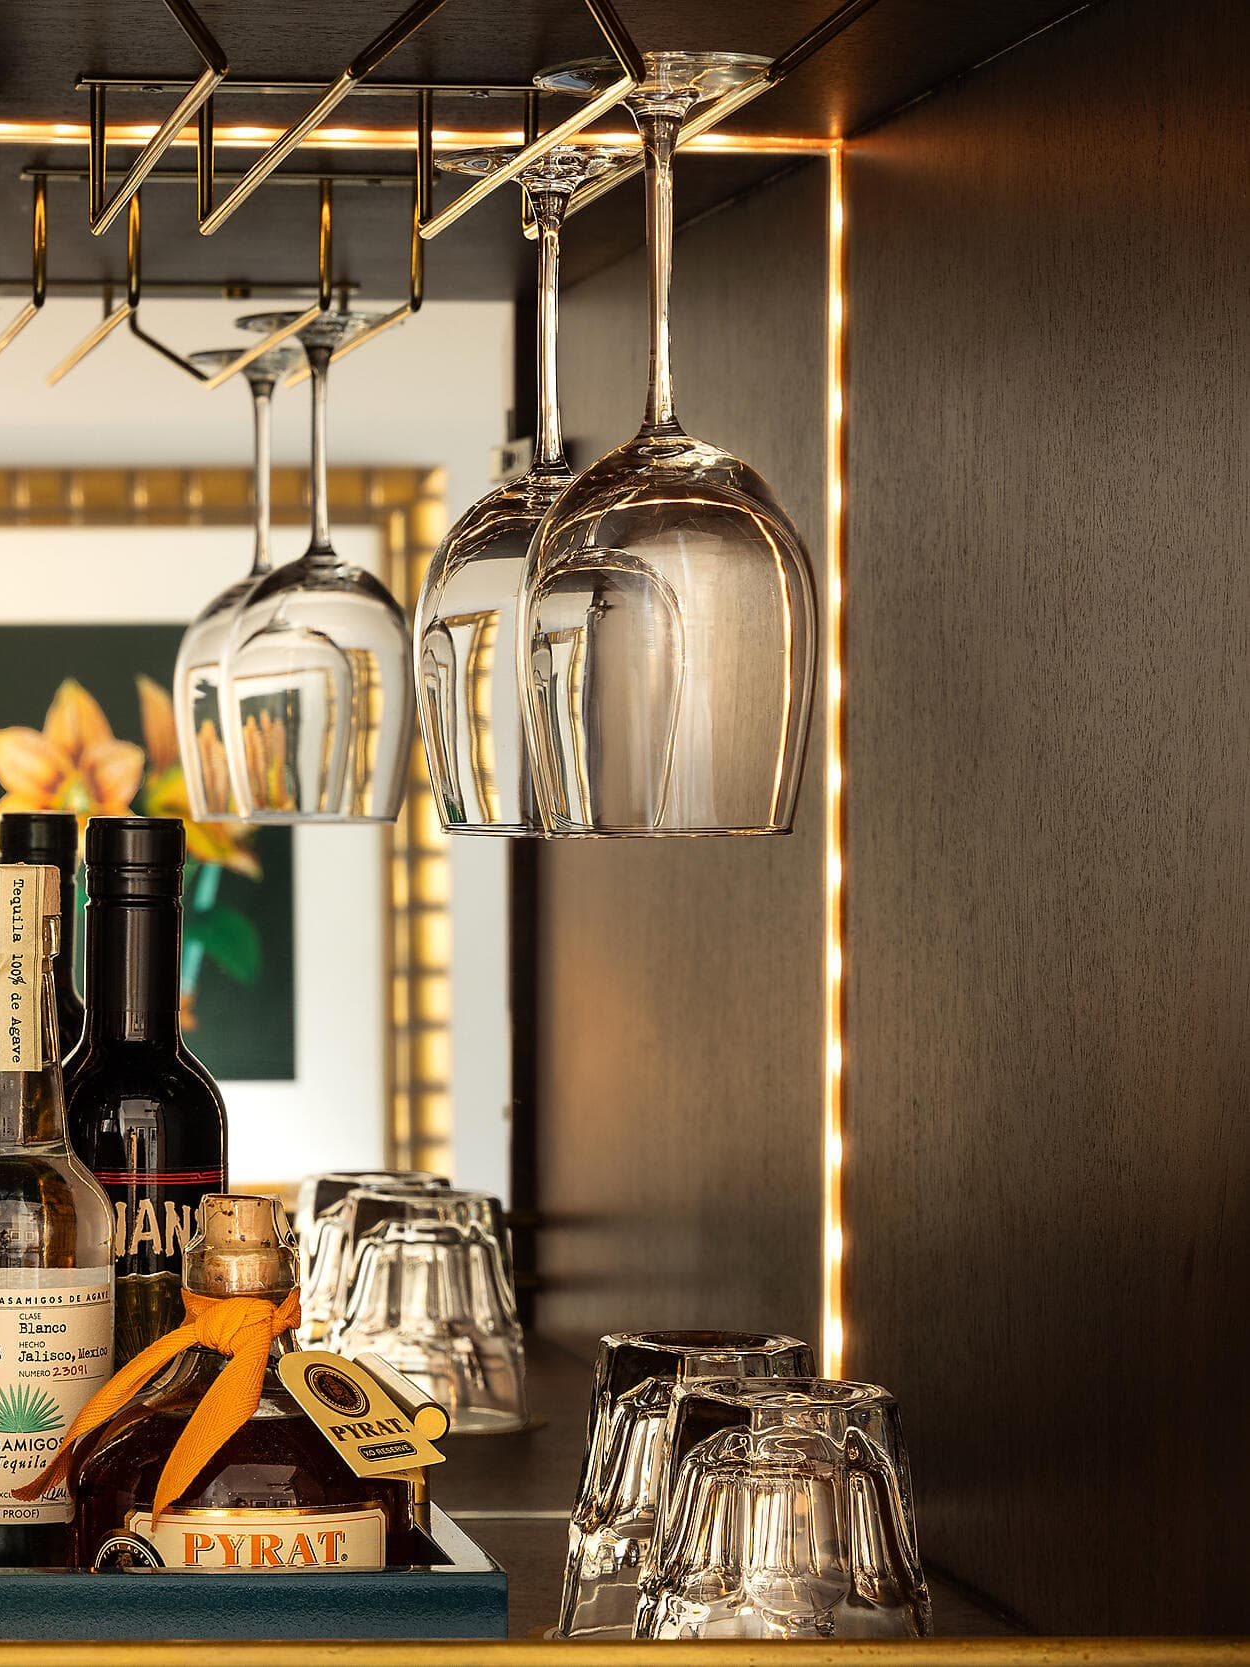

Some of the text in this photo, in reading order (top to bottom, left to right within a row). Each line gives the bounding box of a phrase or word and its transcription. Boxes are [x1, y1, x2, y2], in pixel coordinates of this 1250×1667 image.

[8, 878, 27, 1064] Tequila 100% de Agave
[69, 1294, 81, 1303] DE
[86, 1290, 109, 1302] AGAVE
[19, 1312, 42, 1320] CLASE
[18, 1322, 67, 1334] Blanco
[18, 1340, 46, 1349] HECHO
[18, 1346, 108, 1362] Jalisco, Mexico
[52, 1364, 88, 1377] 23091
[377, 1443, 412, 1457] RESERVE
[2, 1508, 40, 1520] PROOF)
